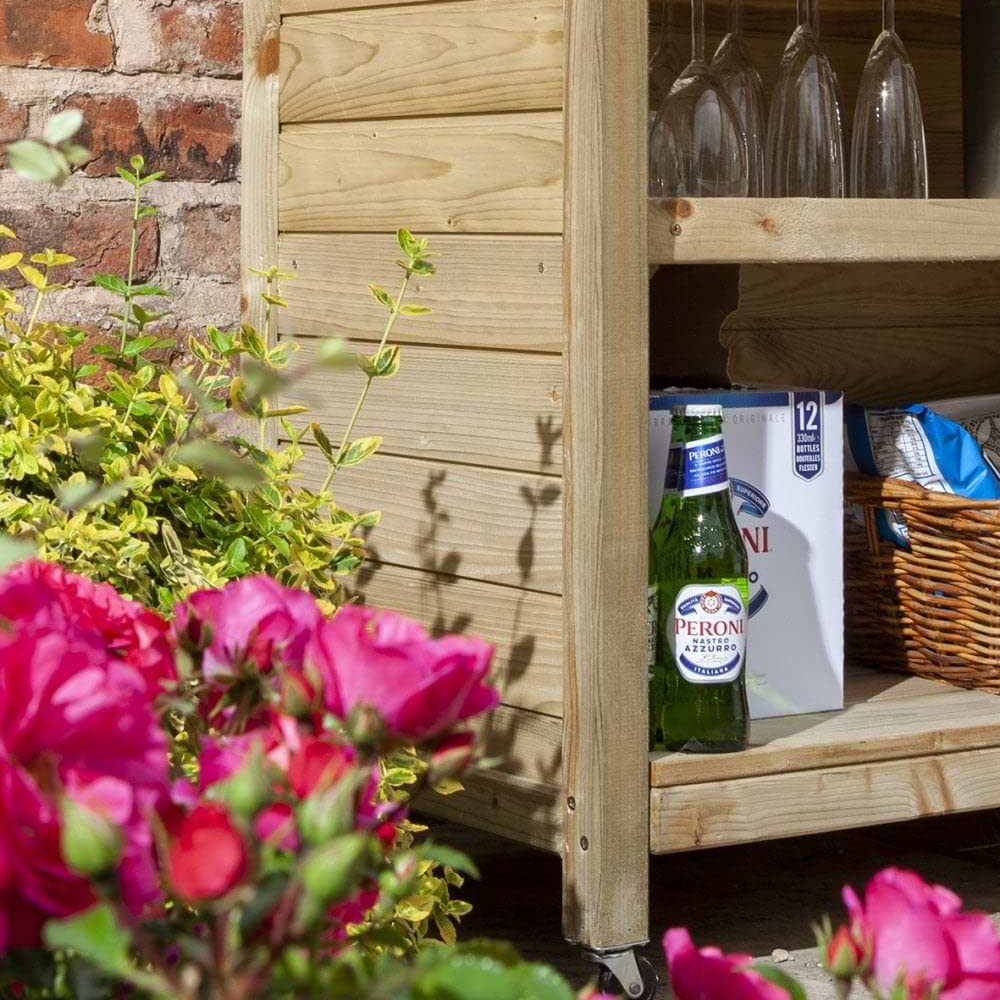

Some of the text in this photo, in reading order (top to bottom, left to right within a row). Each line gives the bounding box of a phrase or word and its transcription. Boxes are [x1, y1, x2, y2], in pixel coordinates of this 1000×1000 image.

[733, 413, 786, 425] ORIGINALE
[796, 400, 818, 431] 12
[796, 444, 820, 453] BOTTLES
[674, 618, 744, 636] PERONI
[684, 644, 737, 653] AZZURRO
